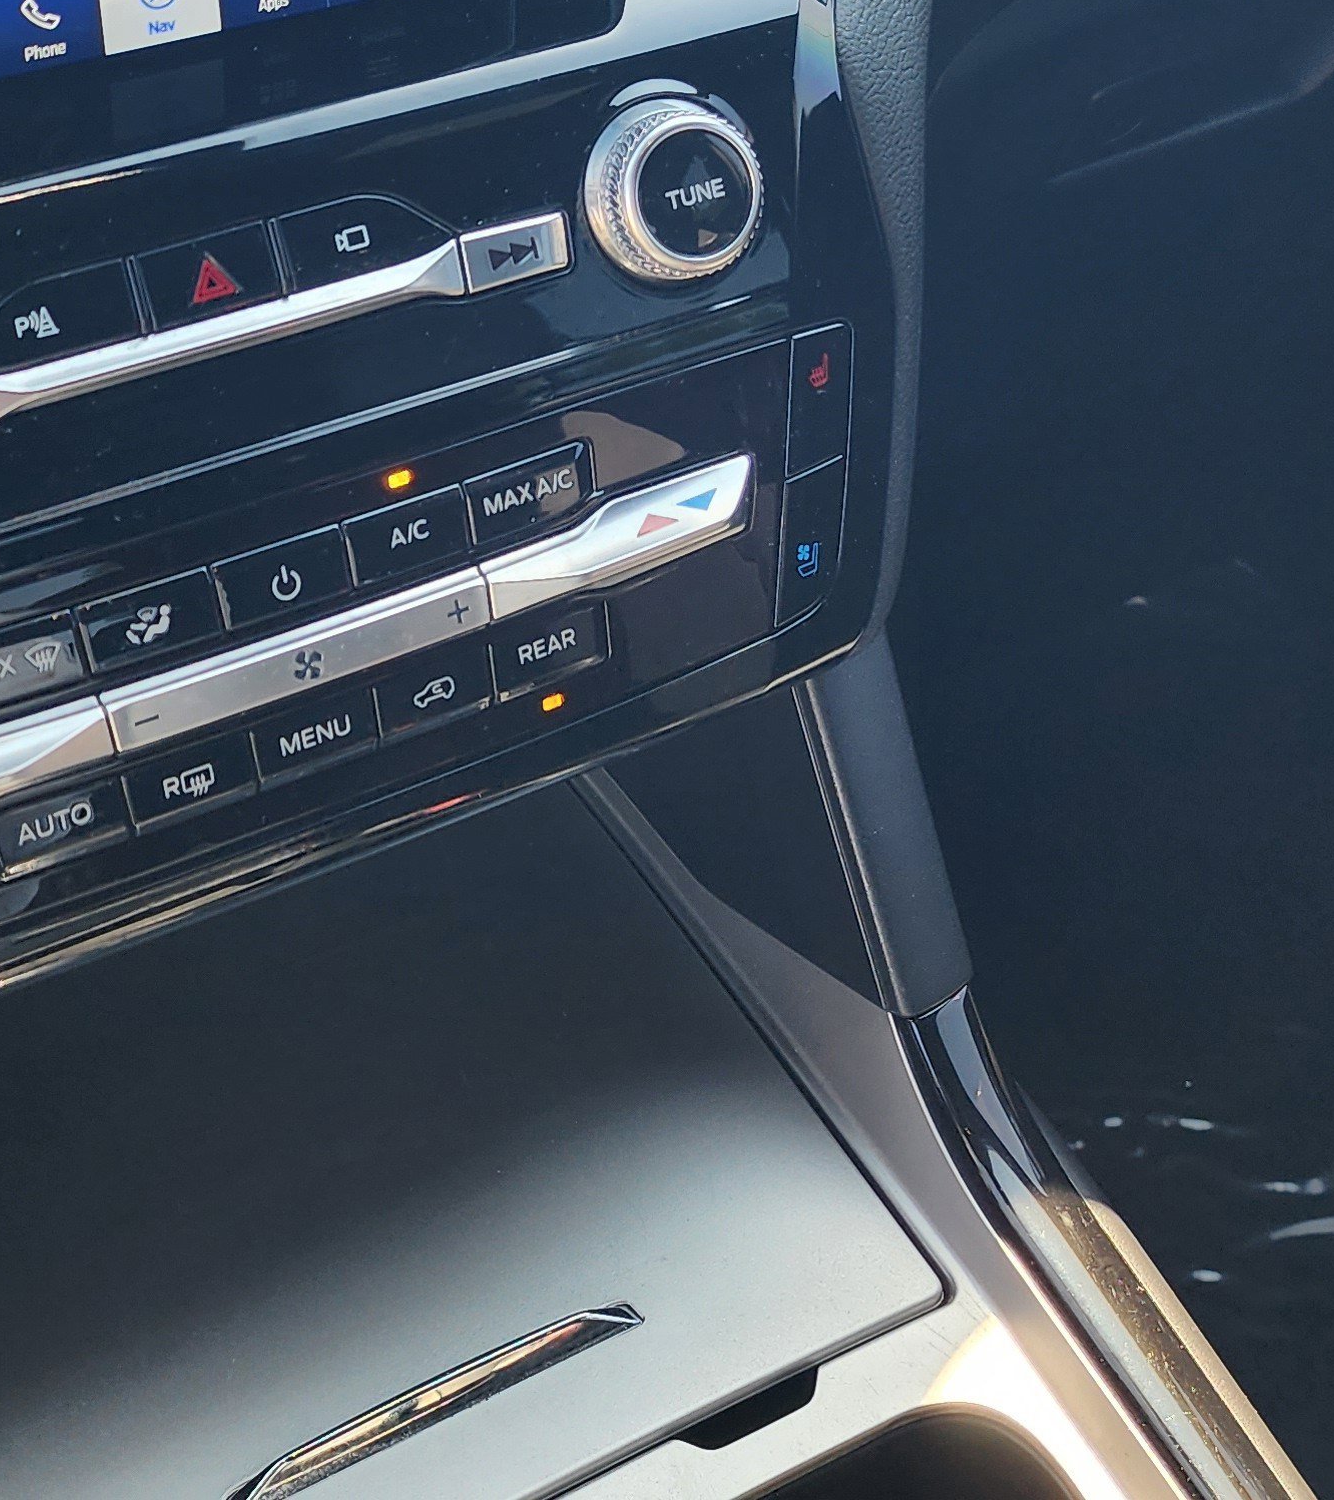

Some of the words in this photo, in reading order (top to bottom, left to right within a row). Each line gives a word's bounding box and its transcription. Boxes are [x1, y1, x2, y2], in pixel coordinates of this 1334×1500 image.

[148, 19, 176, 36] Nav
[24, 41, 67, 62] Phone
[664, 177, 726, 211] TUNE
[482, 481, 535, 518] MAX
[535, 468, 574, 500] A/C
[389, 517, 431, 550] A/C
[517, 627, 577, 665] REAR
[278, 712, 352, 758] MENU
[18, 802, 93, 847] AUTO
